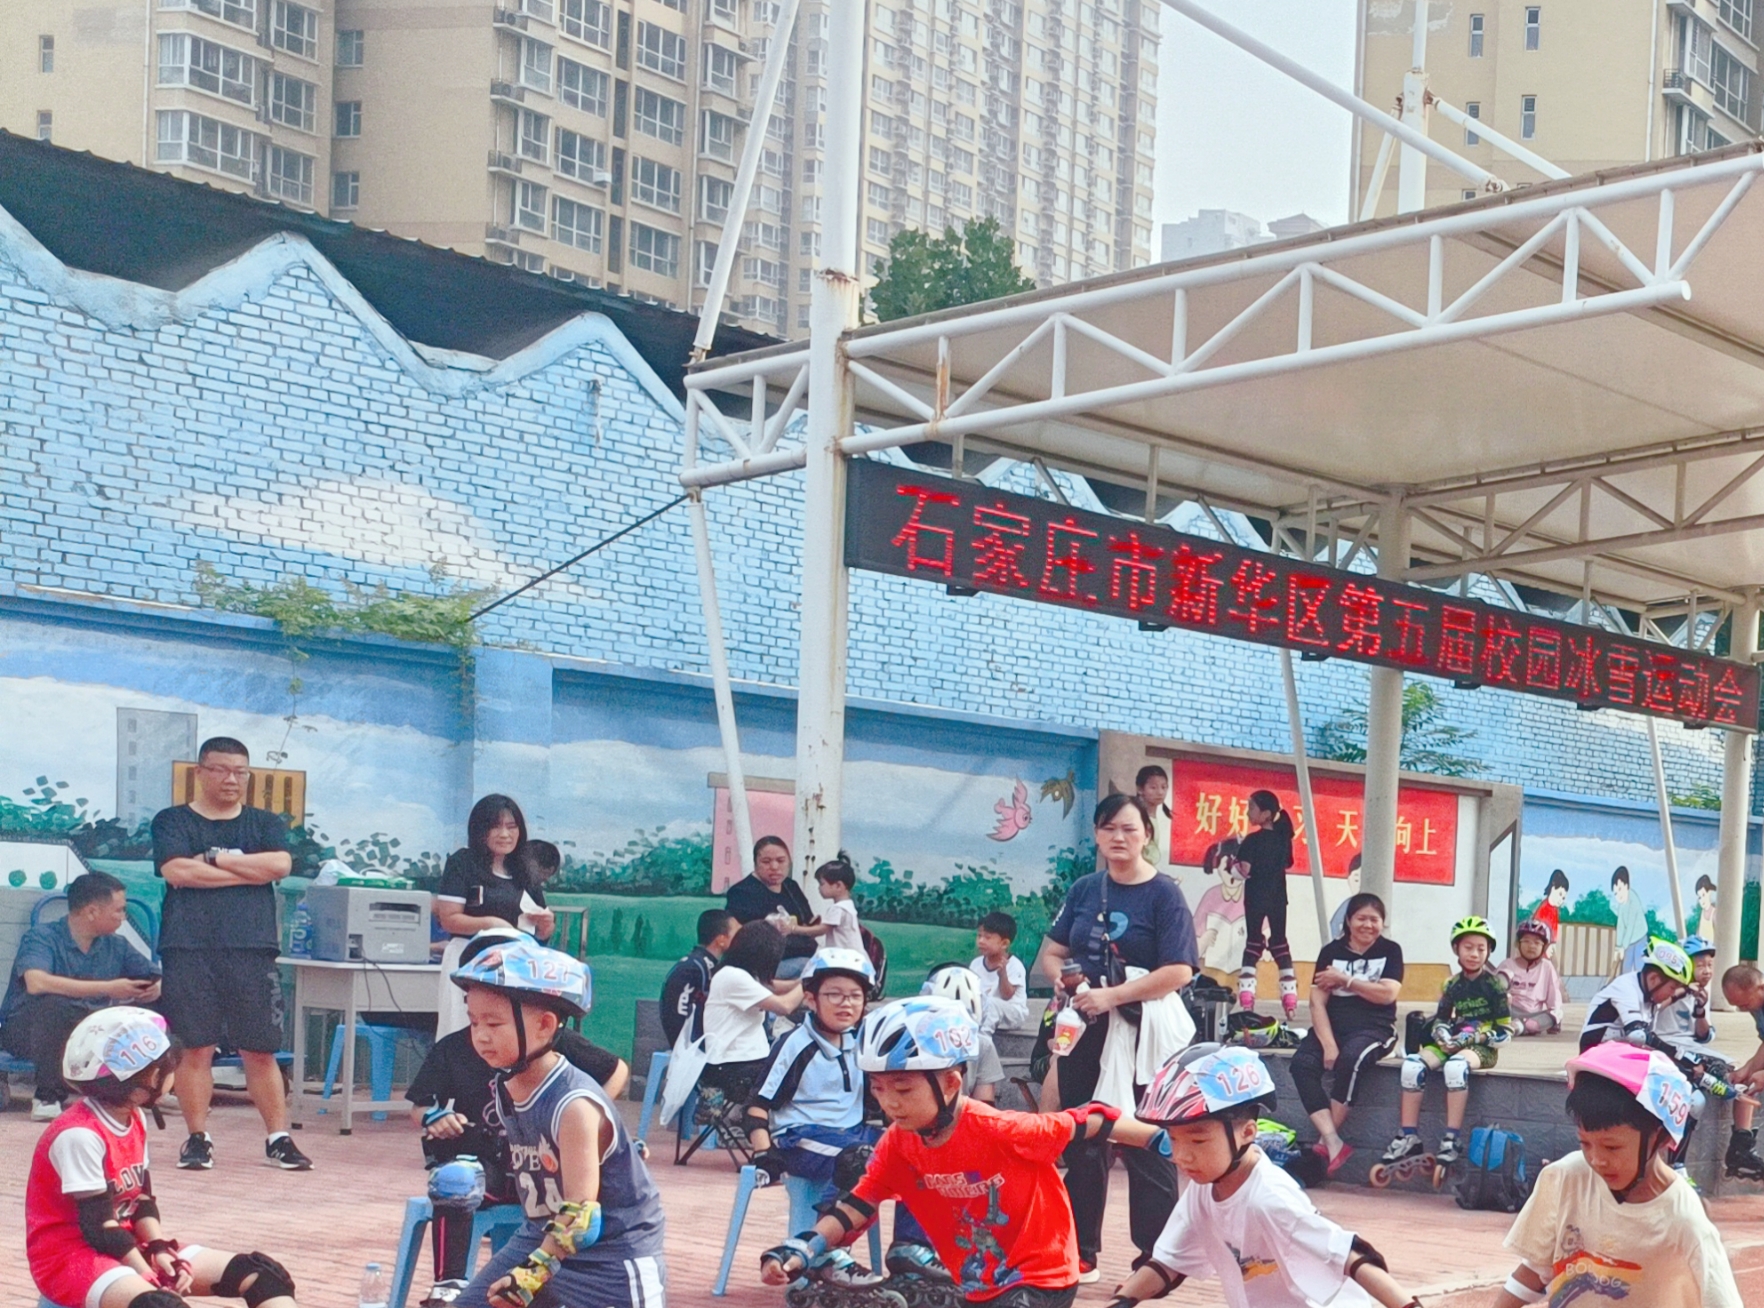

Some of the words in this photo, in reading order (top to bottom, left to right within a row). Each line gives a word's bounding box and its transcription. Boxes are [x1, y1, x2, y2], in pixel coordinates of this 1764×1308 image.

[891, 484, 1744, 725] 石家庄市新华区第五届校园冰雪运动会
[527, 959, 569, 982] 127
[120, 1035, 157, 1066] 116
[934, 1026, 972, 1052] 102
[1217, 1063, 1260, 1095] 126
[1658, 1082, 1688, 1125] 159
